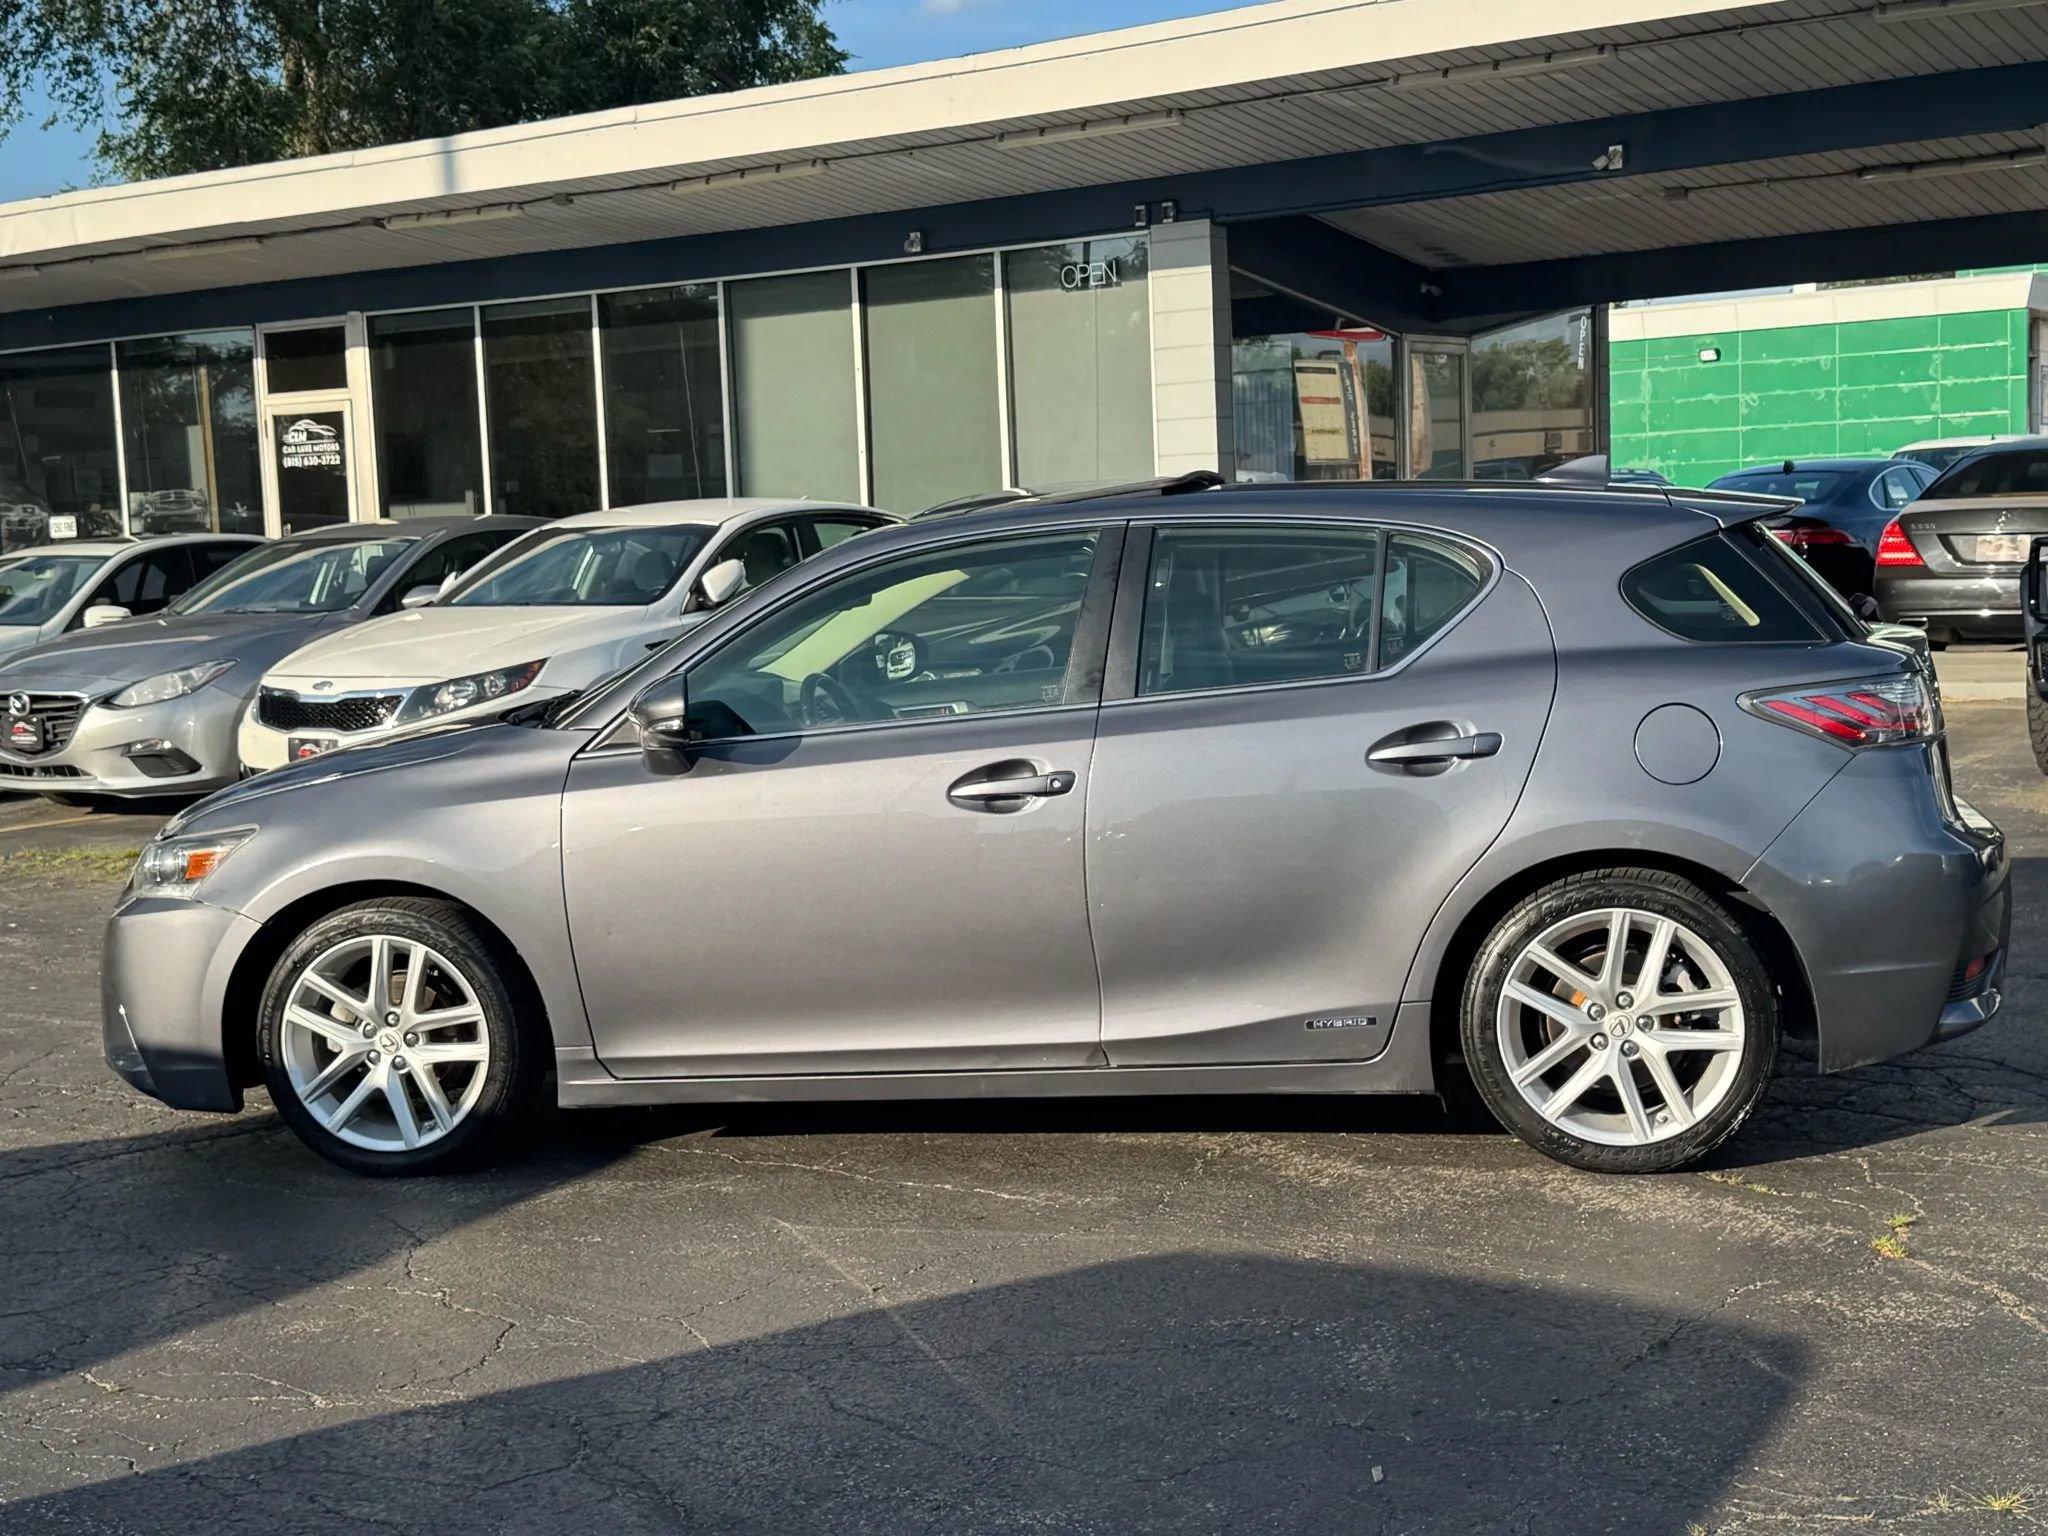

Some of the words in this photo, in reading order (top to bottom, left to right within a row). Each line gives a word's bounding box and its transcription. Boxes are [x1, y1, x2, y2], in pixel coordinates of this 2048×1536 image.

[1061, 260, 1117, 288] OPEN
[1577, 315, 1588, 370] OPEN
[282, 445, 296, 454] CAR
[313, 442, 340, 452] MOTORS
[1313, 1017, 1367, 1029] HYBRID
